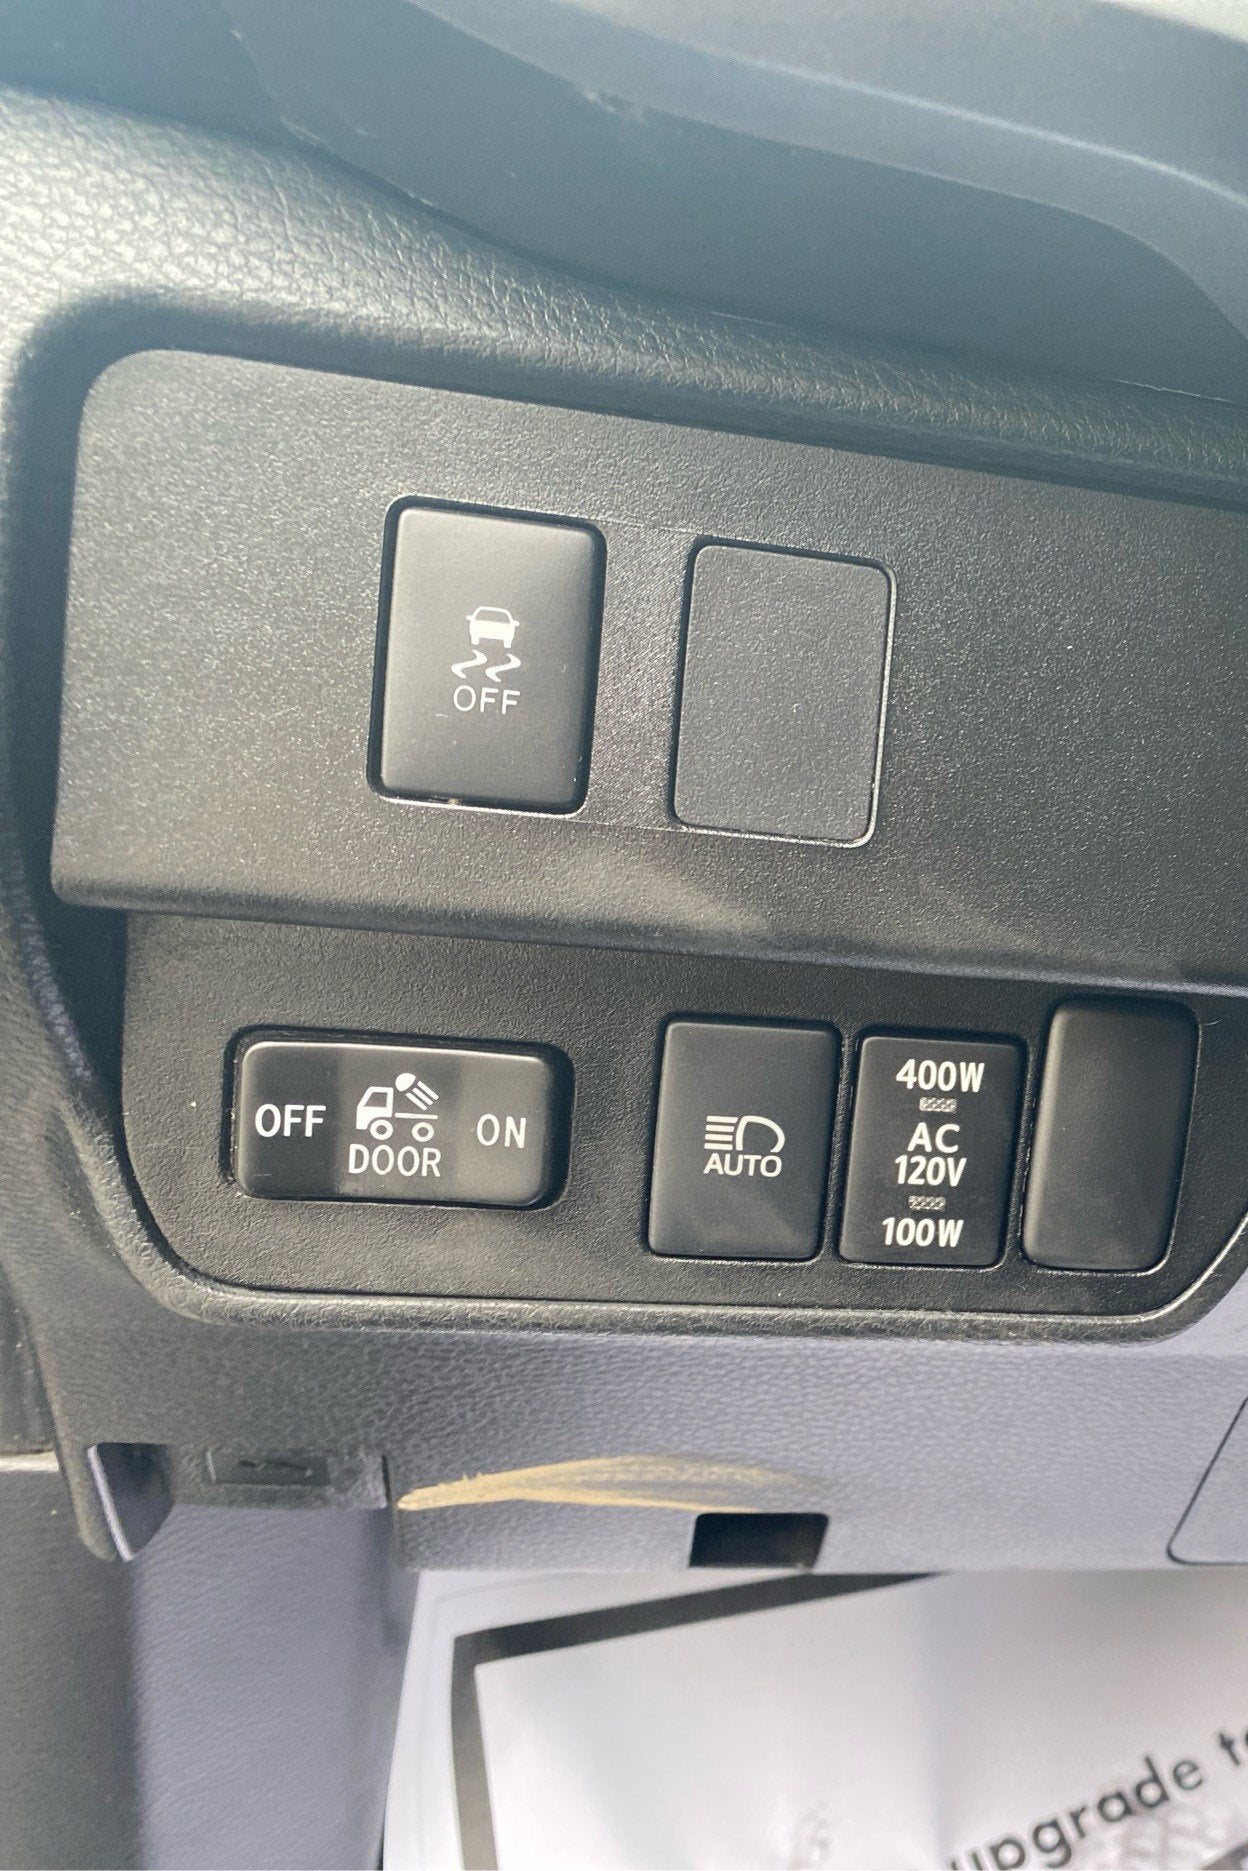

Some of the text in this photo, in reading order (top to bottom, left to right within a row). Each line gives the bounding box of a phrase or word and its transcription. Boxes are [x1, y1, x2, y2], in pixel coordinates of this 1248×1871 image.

[453, 684, 521, 715] OFF
[896, 1059, 985, 1093] 400W
[254, 1103, 327, 1138] OFF
[476, 1113, 527, 1149] ON
[907, 1122, 961, 1154] AC
[348, 1143, 442, 1178] DOOR
[703, 1152, 783, 1178] AUTO
[894, 1154, 967, 1188] 120V
[881, 1217, 964, 1248] 100W
